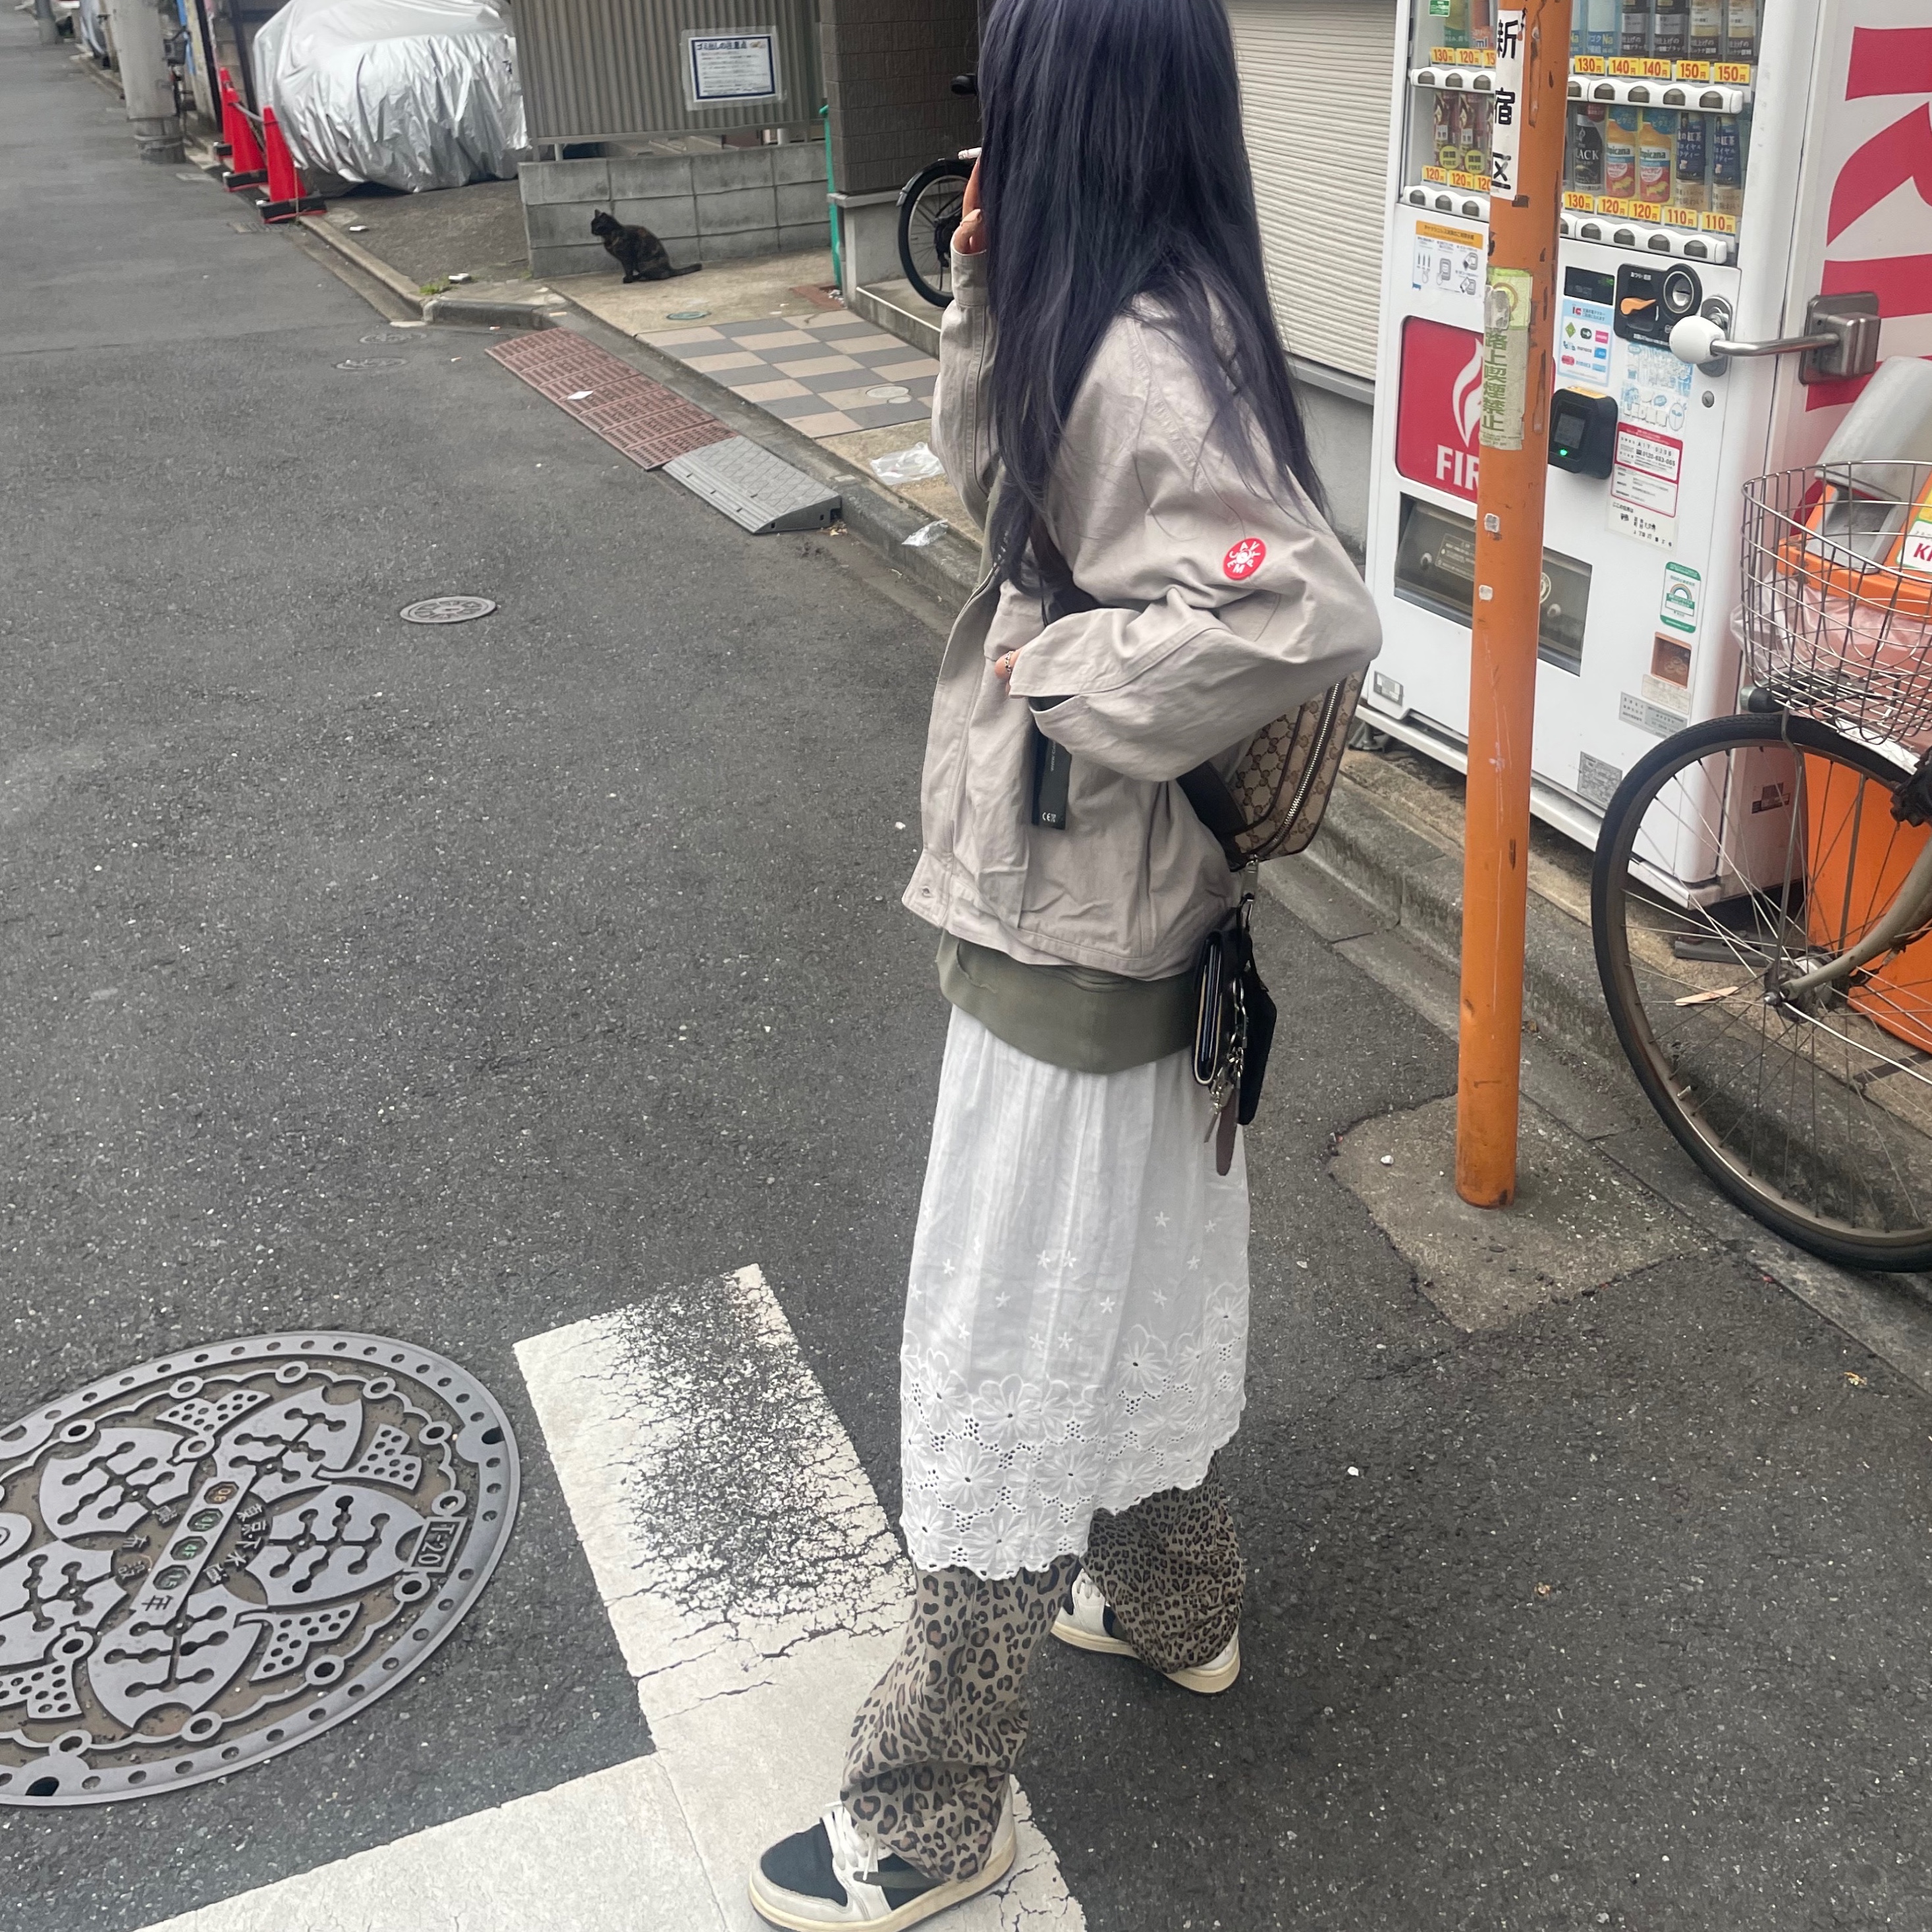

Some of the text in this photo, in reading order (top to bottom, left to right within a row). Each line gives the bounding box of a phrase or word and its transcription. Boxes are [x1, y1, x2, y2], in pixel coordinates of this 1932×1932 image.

[1578, 57, 1602, 72] 130円
[1612, 60, 1636, 75] 140円
[1643, 61, 1668, 76] 140円
[1680, 63, 1706, 78] 150円
[1718, 65, 1746, 82] 150円
[1568, 194, 1590, 209] 130円
[1602, 199, 1625, 215] 120円
[1633, 203, 1657, 220] 120円
[1668, 208, 1694, 226] 110円
[1705, 214, 1732, 232] 110円
[1482, 331, 1508, 432] 路上喫煙禁止
[418, 1524, 456, 1564] T-20
